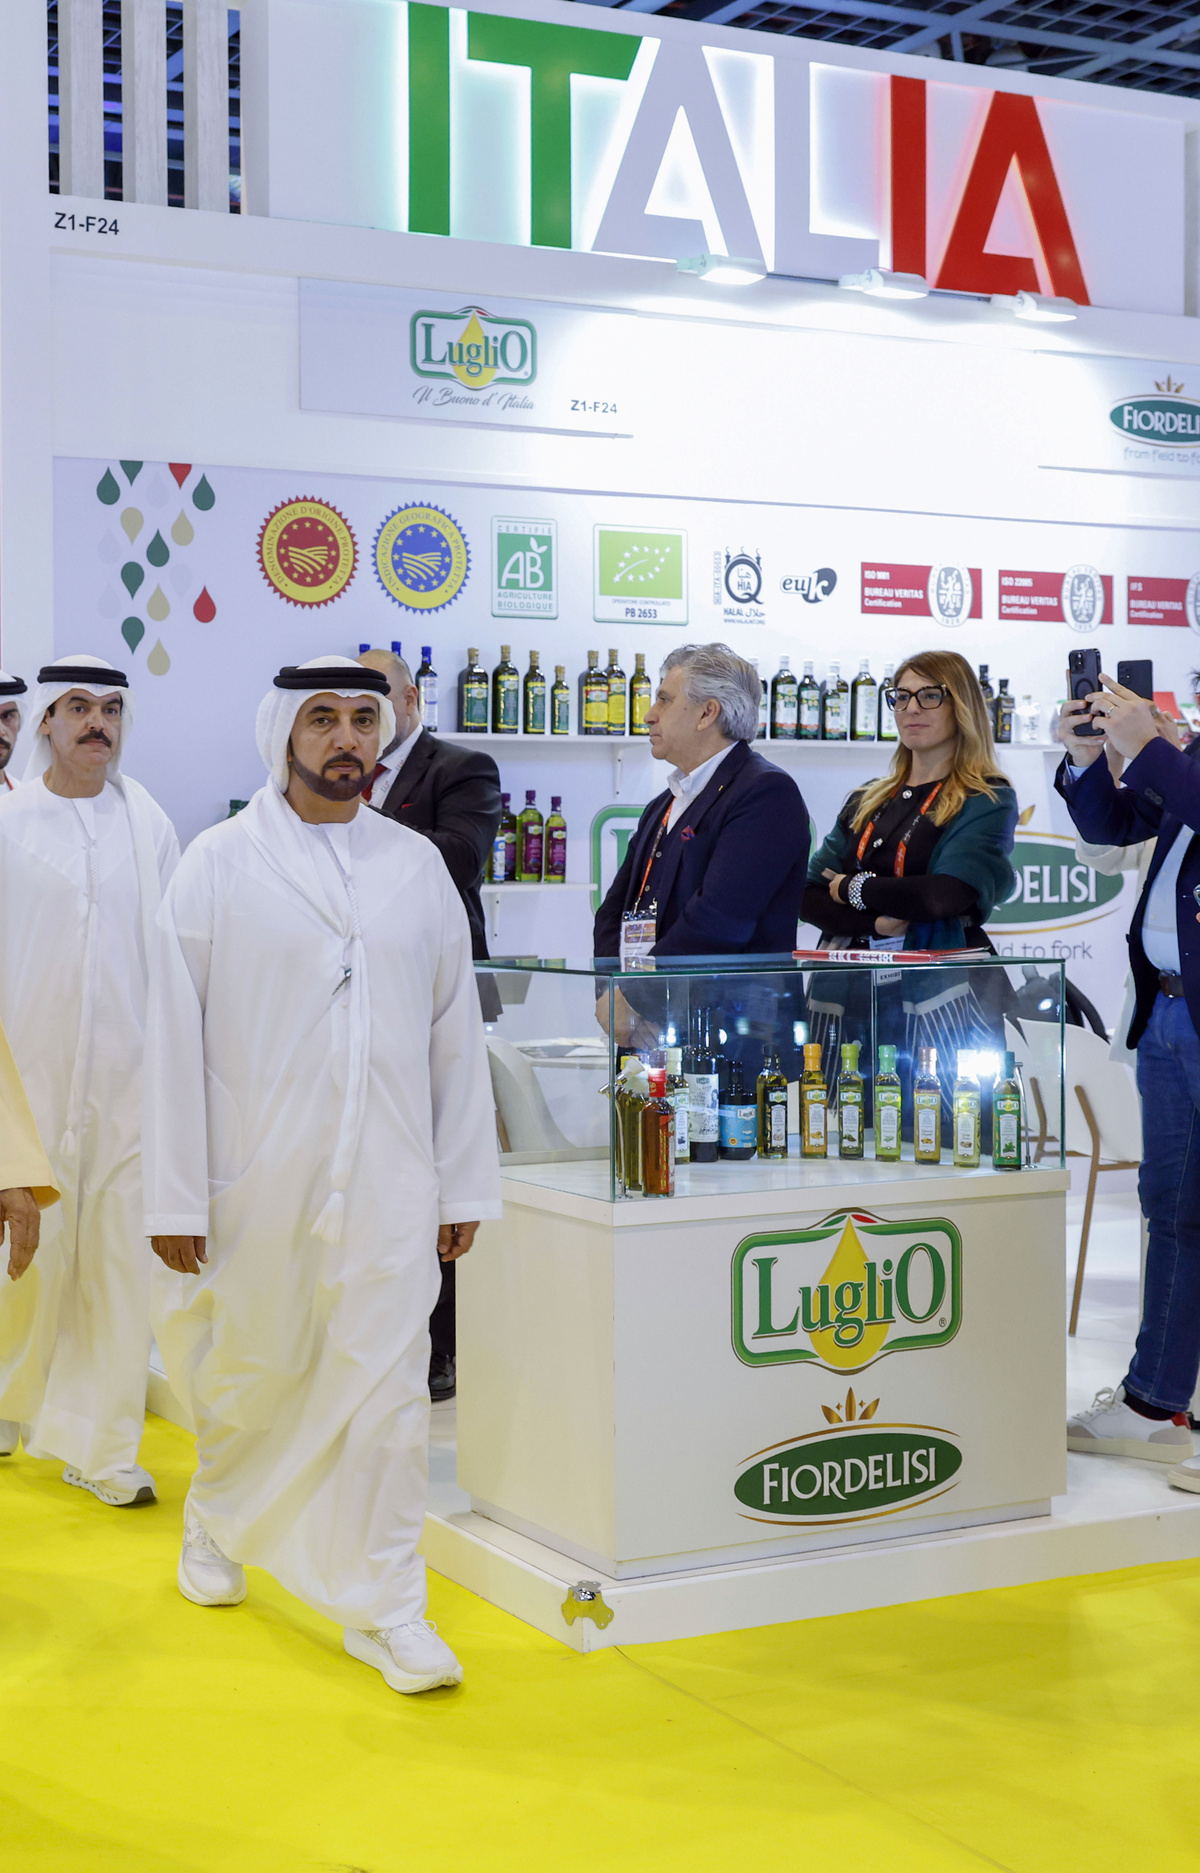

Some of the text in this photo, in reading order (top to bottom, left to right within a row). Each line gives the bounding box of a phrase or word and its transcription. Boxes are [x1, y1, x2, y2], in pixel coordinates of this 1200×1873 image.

[407, 4, 1091, 306] ITALIA
[54, 211, 120, 236] Z1-F24
[421, 322, 529, 377] LugliO
[570, 400, 618, 414] Z1-F24
[266, 505, 350, 586] DENOMINAZIONE D'ORIGINE PROTETTA
[382, 512, 464, 589] INDICAZIONE GEOGRAFICA PROTETTA
[501, 550, 545, 588] AB
[737, 581, 752, 591] HIA
[864, 586, 924, 599] BUREAU VERITAS
[497, 592, 552, 601] AGRICULTURE
[498, 601, 552, 610] BIOLOGIQUE
[1001, 594, 1058, 607] BUREAU VERITAS
[625, 607, 658, 618] PB 2653
[724, 608, 744, 616] HALAL
[1022, 943, 1046, 958] to
[1051, 940, 1093, 960] fork
[752, 1242, 946, 1347] LugliO
[762, 1447, 936, 1505] FIORDELISI
